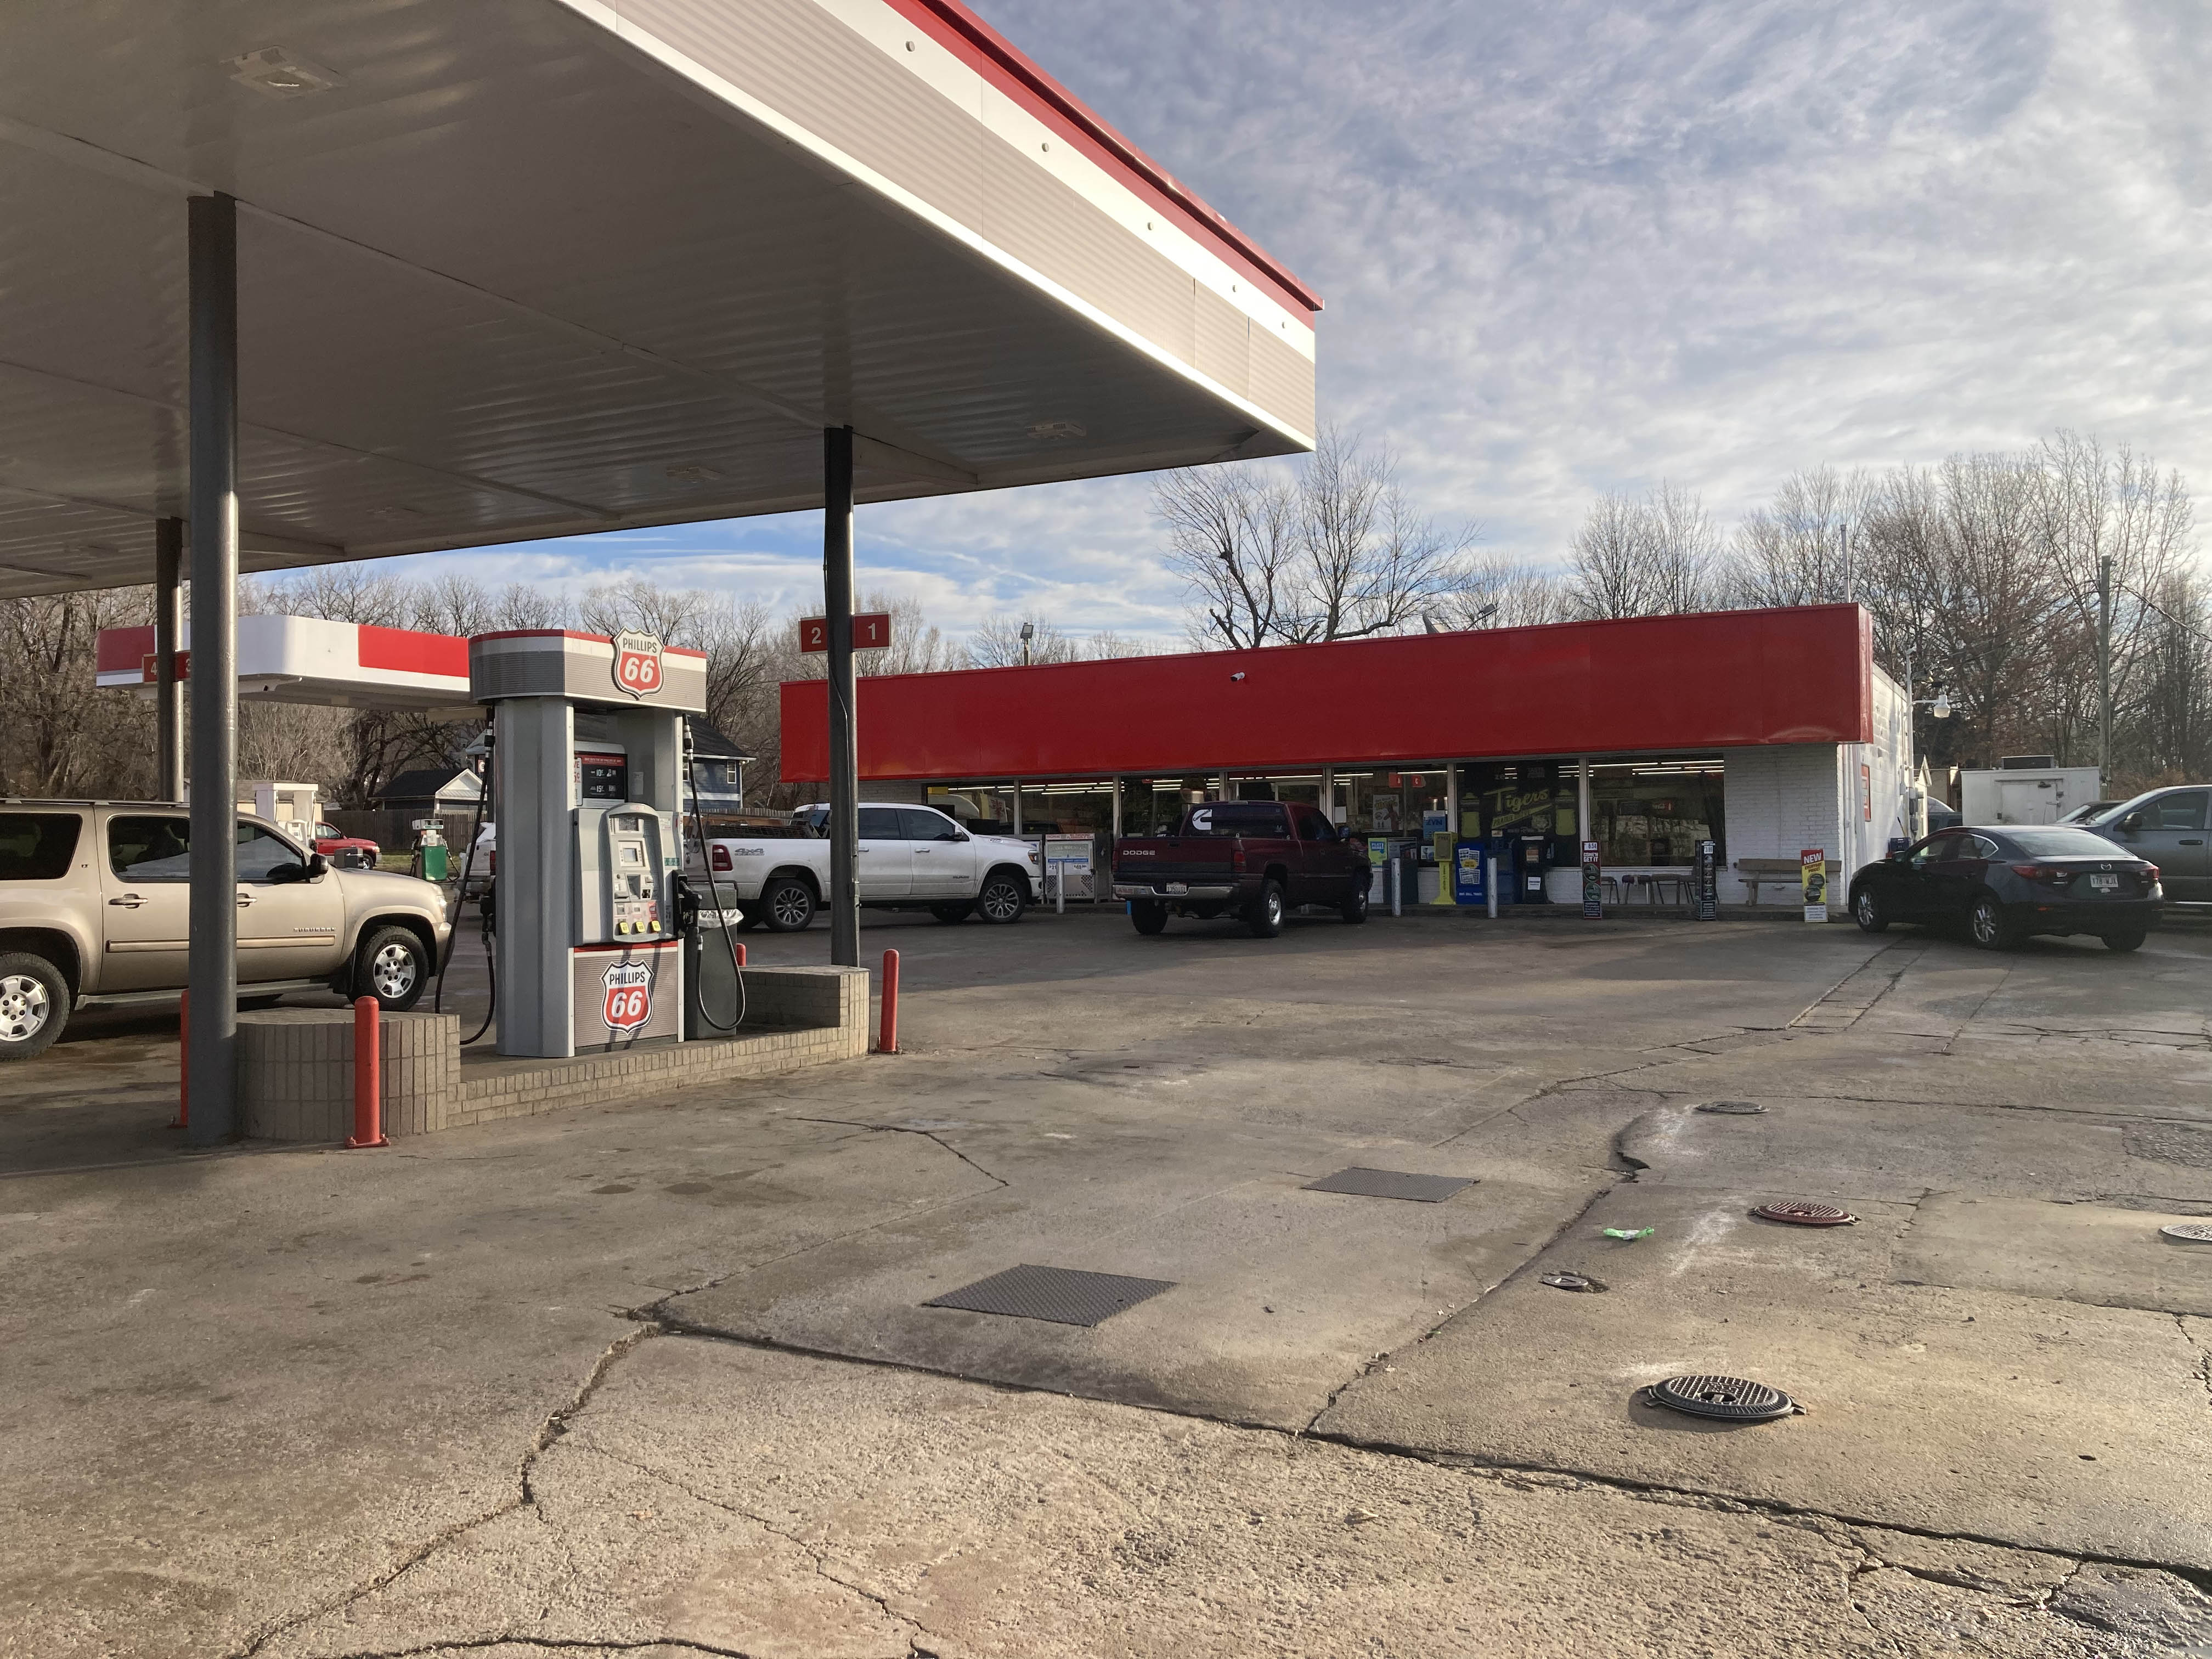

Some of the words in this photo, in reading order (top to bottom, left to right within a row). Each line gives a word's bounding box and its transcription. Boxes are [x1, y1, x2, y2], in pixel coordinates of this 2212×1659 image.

[811, 627, 821, 644] 2
[868, 623, 876, 640] 1
[623, 637, 657, 653] PHILLIPS
[150, 661, 157, 675] 4
[624, 657, 655, 683] 66
[1483, 786, 1549, 814] Tigers
[1803, 852, 1821, 864] NEW
[610, 971, 646, 985] PHILLIPS
[611, 990, 644, 1018] 66
